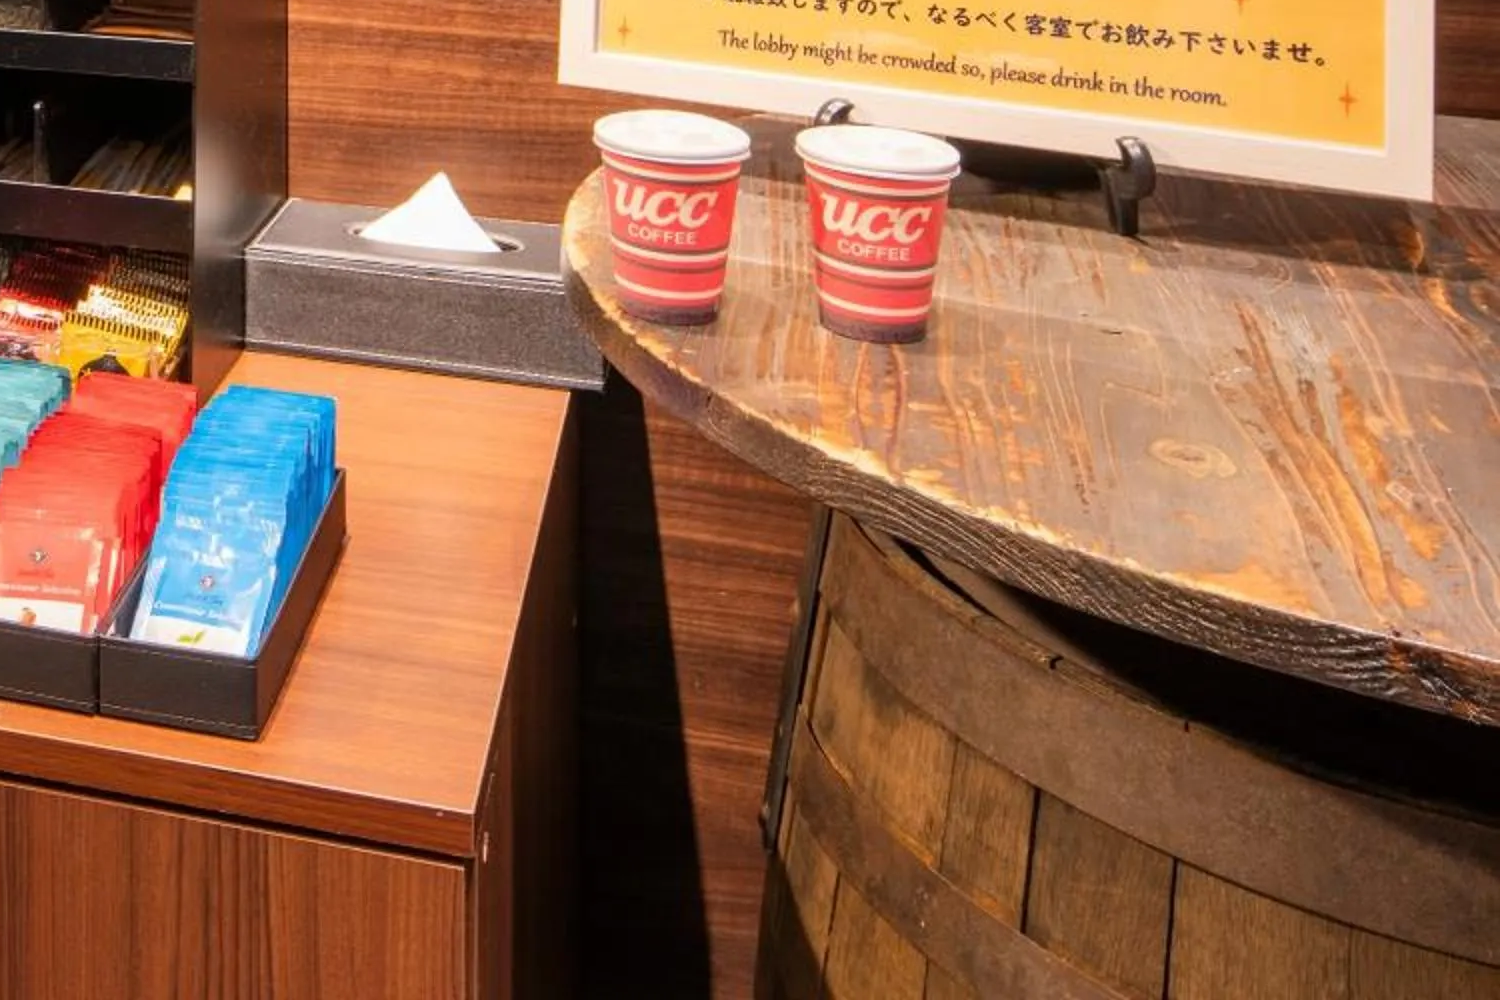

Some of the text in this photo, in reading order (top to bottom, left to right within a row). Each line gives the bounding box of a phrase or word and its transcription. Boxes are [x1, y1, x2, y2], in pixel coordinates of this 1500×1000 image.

[718, 29, 1227, 108] The lobby might be crowded so, please drink in the room.
[613, 176, 718, 228] UCC
[820, 191, 933, 244] UCC
[627, 222, 697, 246] COFFEE
[836, 238, 911, 263] COFFEE
